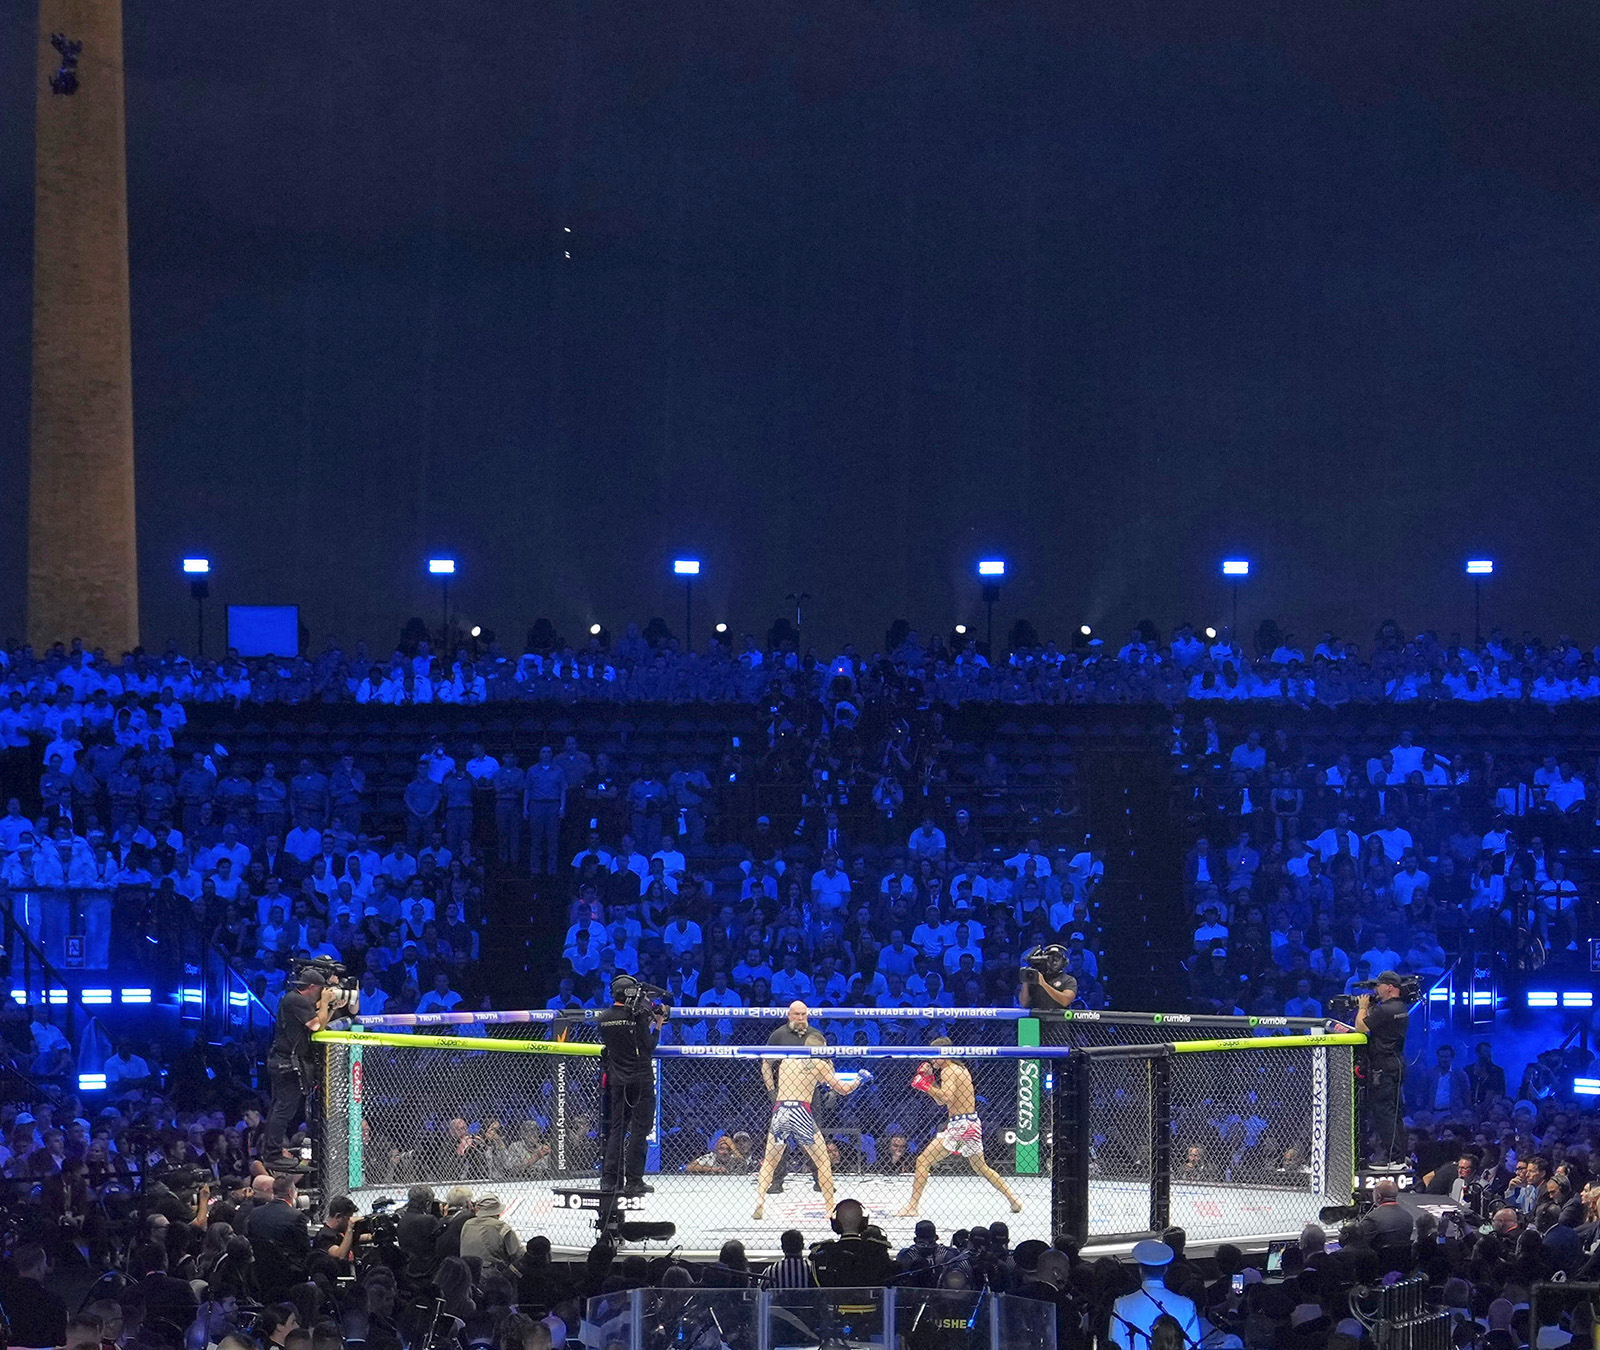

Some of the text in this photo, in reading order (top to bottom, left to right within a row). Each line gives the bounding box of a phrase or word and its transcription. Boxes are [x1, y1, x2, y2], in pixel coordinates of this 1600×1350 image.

[474, 1013, 498, 1021] TRUTH
[531, 1012, 553, 1020] TRUTH
[681, 1007, 823, 1018] LIVETRADE ON Polymket
[855, 1007, 997, 1018] LIVETRADE ON Polymarket
[1074, 1011, 1100, 1021] rumble
[361, 1016, 384, 1024] TRUTH
[418, 1014, 441, 1022] TRUTH
[1163, 1014, 1191, 1023] rumble
[1259, 1016, 1287, 1025] rumble
[681, 1047, 739, 1055] BUD LIGHT
[811, 1047, 868, 1055] BUD LIGHT
[941, 1047, 998, 1055] BUD LIGHT
[557, 1093, 565, 1128] Liberty
[1312, 1067, 1322, 1194] crypto.com
[558, 1128, 566, 1170] Financial
[935, 1318, 967, 1329] USHE
